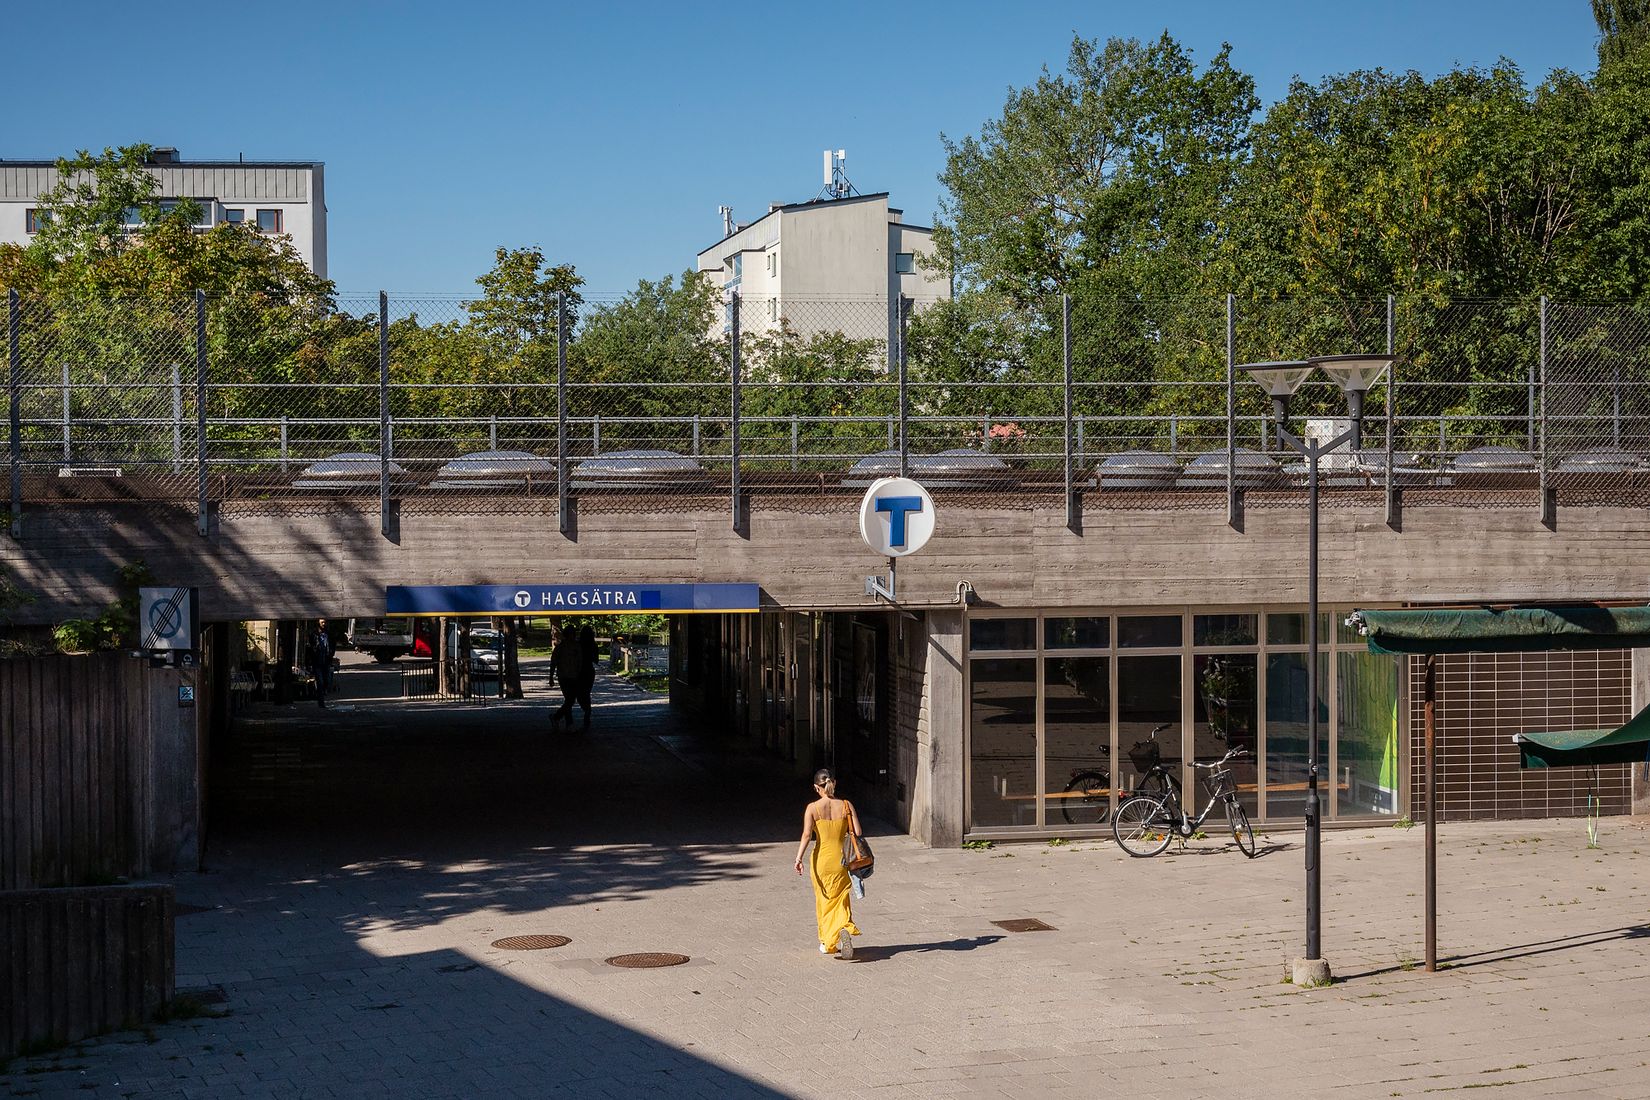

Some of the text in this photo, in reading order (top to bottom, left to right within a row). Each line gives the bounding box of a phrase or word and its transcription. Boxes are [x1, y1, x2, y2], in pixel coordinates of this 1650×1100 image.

[875, 496, 922, 547] T
[517, 589, 637, 606] T HAGSÄTRA
